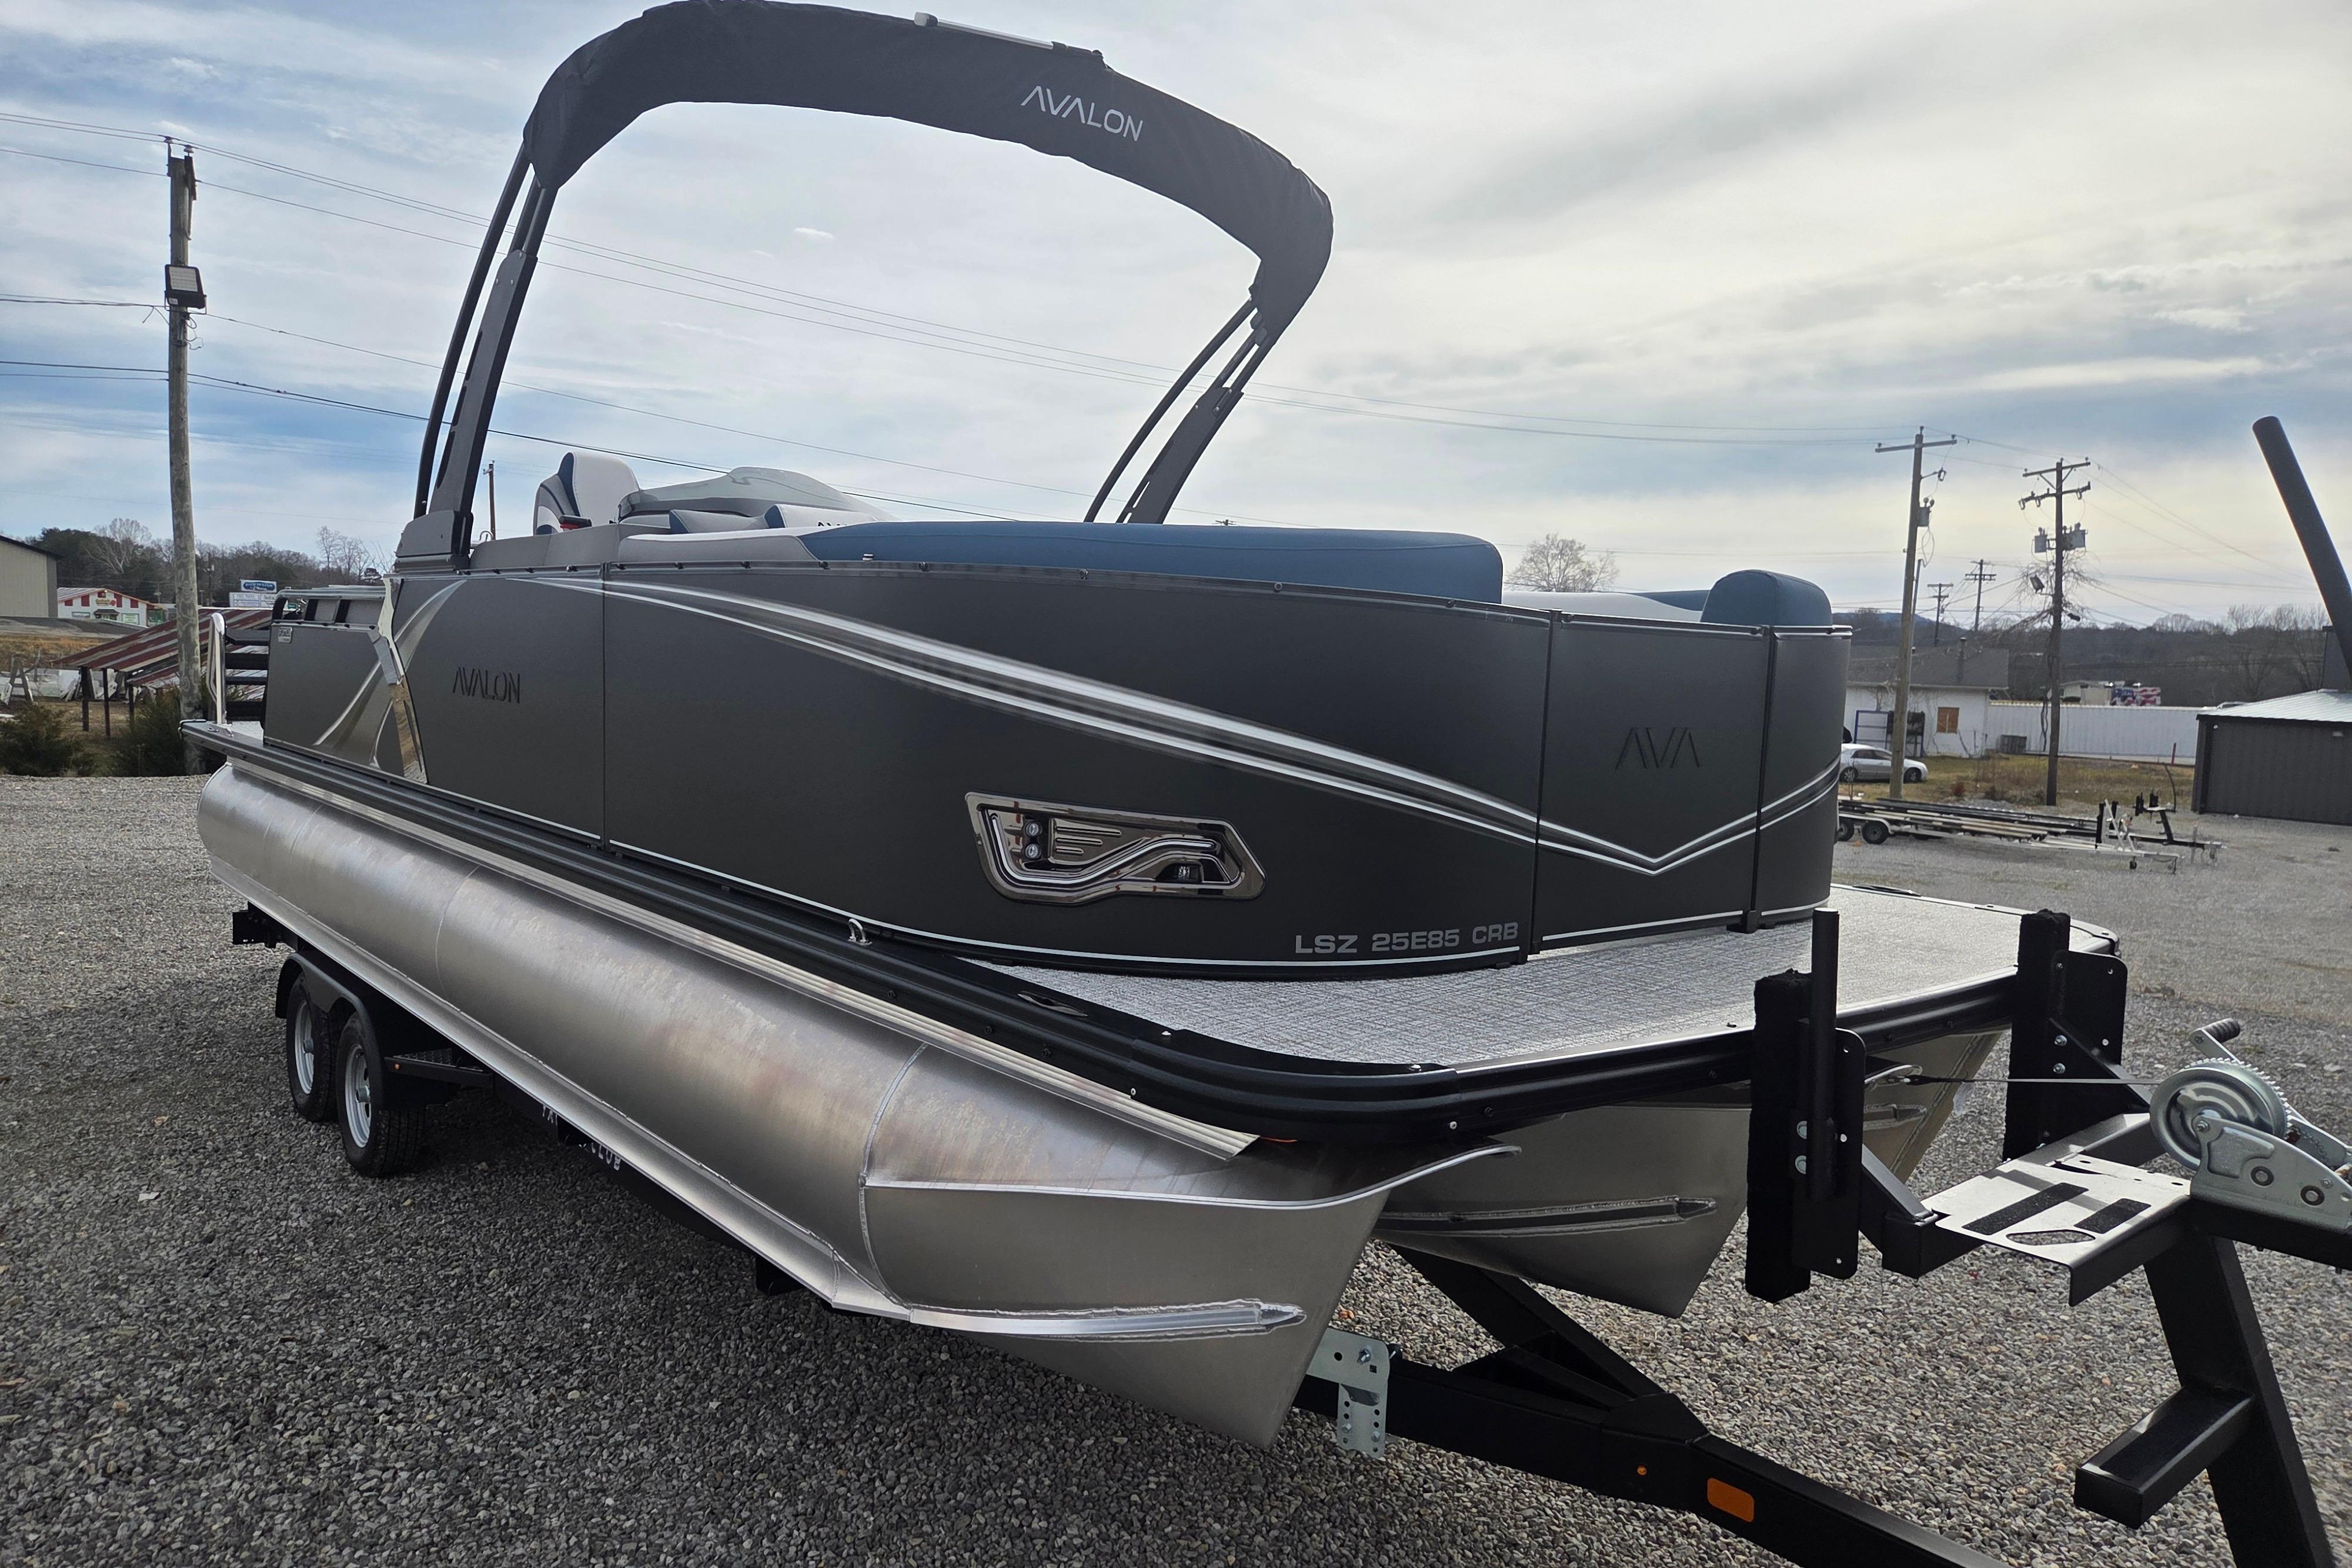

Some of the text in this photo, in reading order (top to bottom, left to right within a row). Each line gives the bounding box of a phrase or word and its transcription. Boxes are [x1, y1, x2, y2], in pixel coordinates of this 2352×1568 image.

[1020, 85, 1144, 142] AVALON
[452, 666, 520, 704] AVALON
[1615, 727, 1700, 770] AVA
[1294, 921, 1519, 954] LSZ 25E85 CRB
